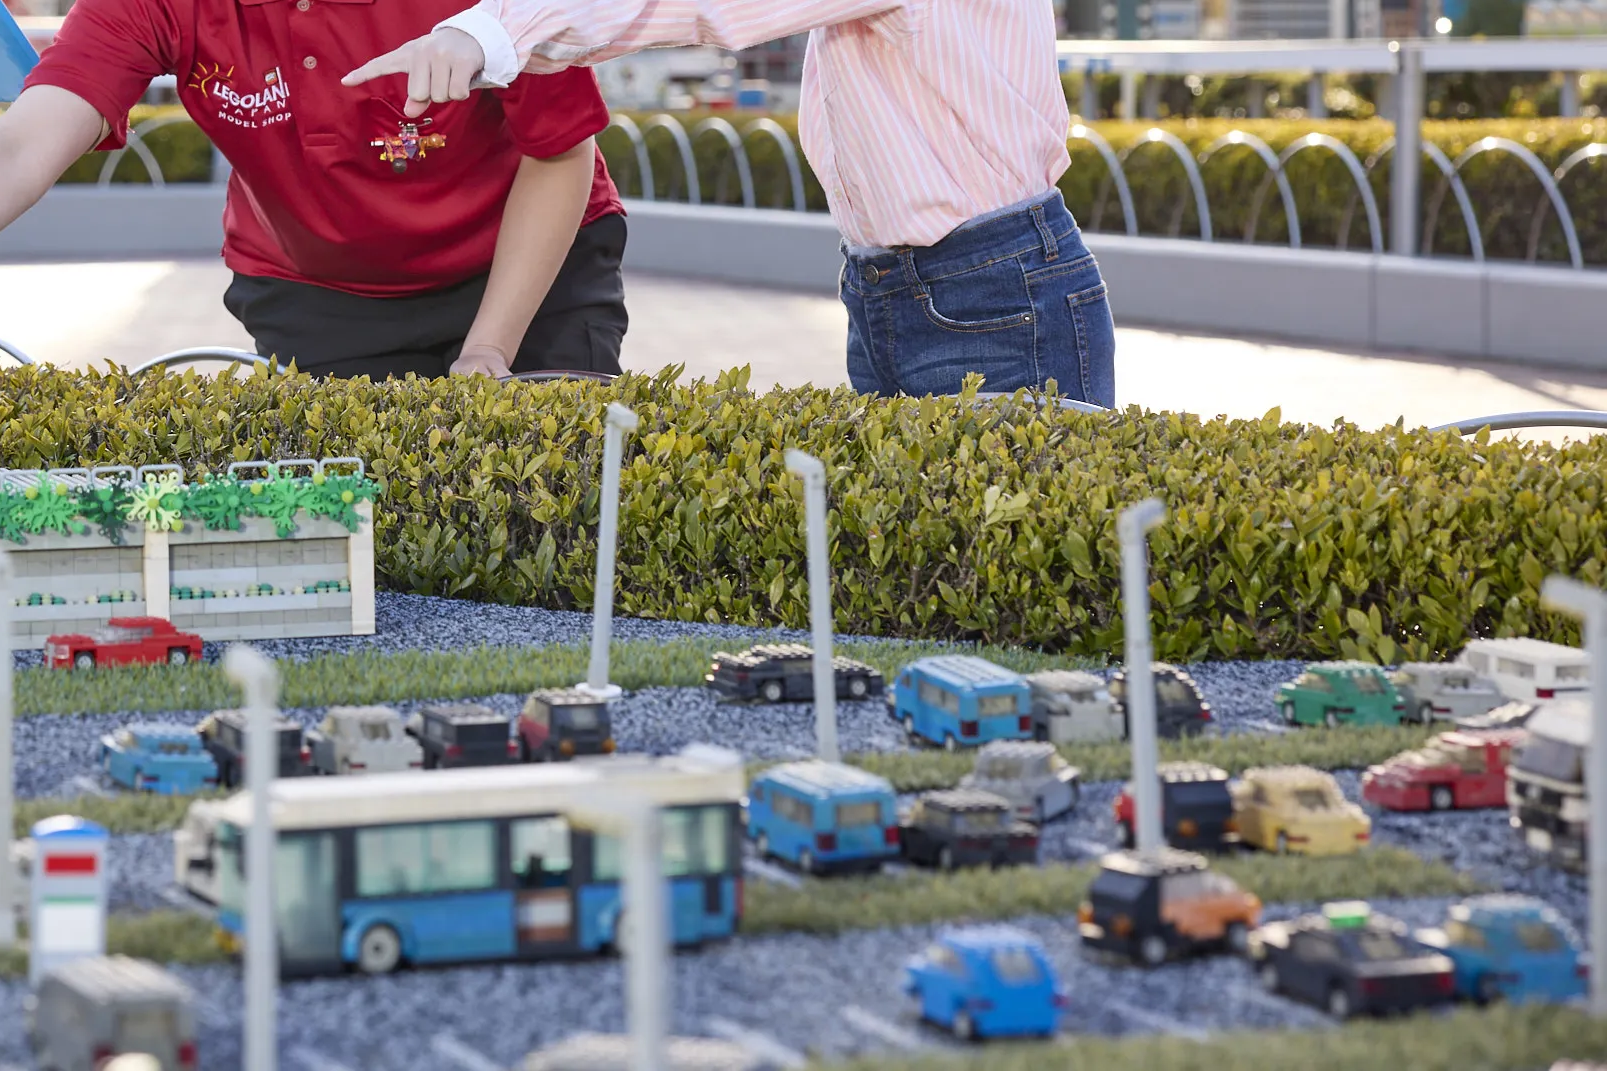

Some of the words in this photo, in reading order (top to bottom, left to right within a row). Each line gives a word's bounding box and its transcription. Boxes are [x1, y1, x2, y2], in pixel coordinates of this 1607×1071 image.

[213, 67, 290, 109] LEGOLAN
[222, 98, 286, 118] JAPAN
[218, 110, 258, 128] MODEL
[262, 112, 292, 127] SHOP
